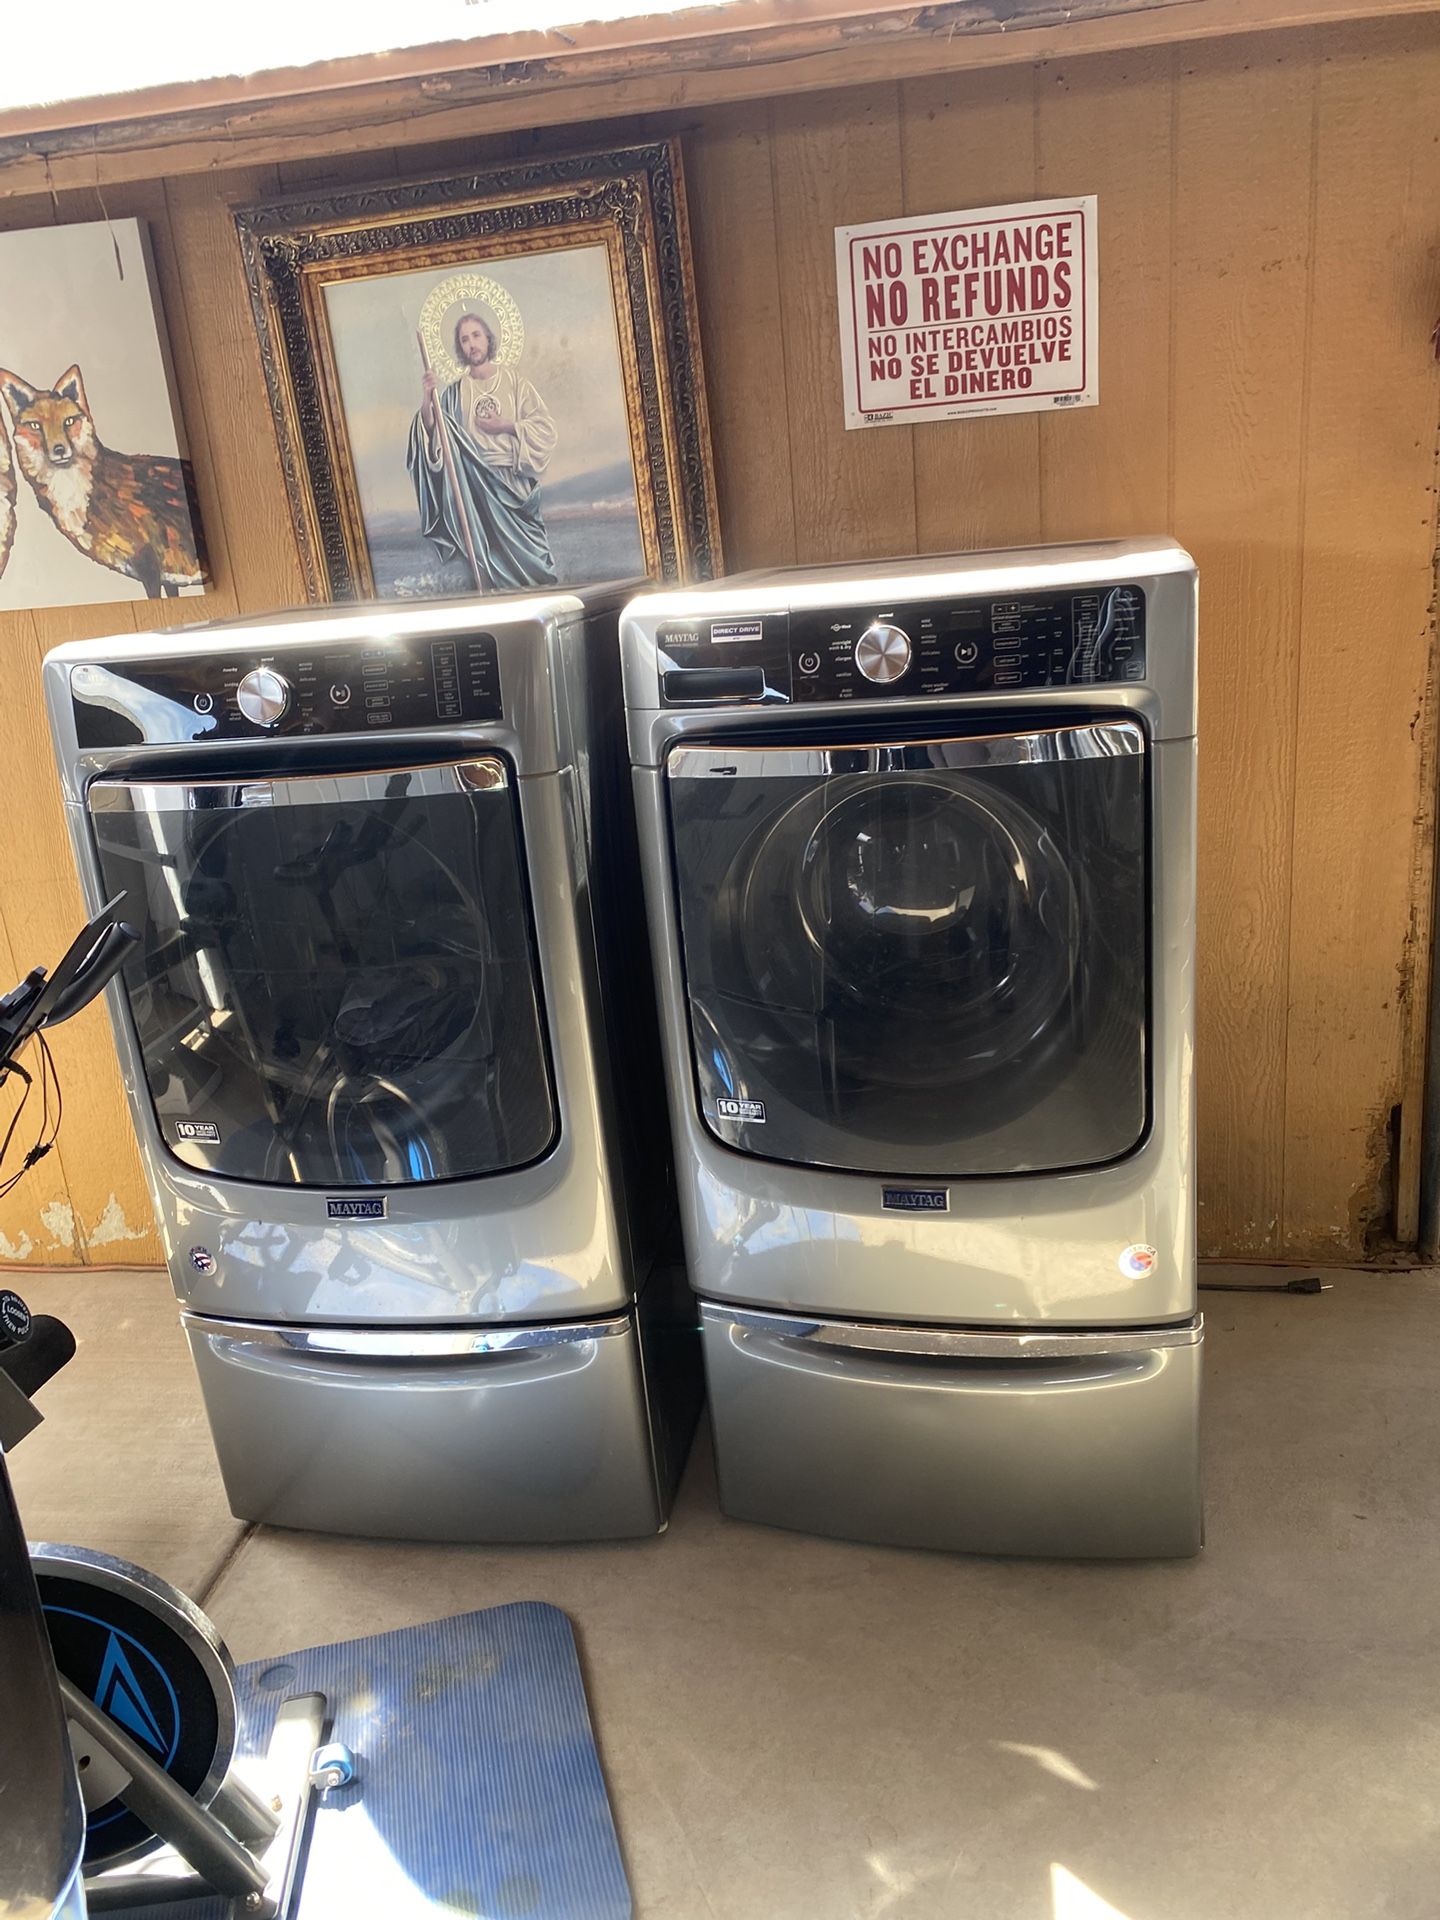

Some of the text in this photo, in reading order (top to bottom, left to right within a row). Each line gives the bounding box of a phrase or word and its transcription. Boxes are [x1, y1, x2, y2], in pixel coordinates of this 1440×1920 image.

[863, 222, 1072, 280] NO EXCHANGE
[866, 261, 1072, 328] NO REFUNDS
[868, 315, 1072, 358] NO INTERCAMBIOS
[870, 340, 1072, 381] NO SE DEVUELVE
[910, 367, 1032, 400] EL DINERO
[664, 633, 699, 643] MAYTAG
[713, 627, 738, 635] DIRECT
[720, 1101, 738, 1113] 10
[178, 1124, 195, 1136] 10
[885, 1192, 944, 1207] MAYTAG
[329, 1203, 382, 1215] MAYTAG
